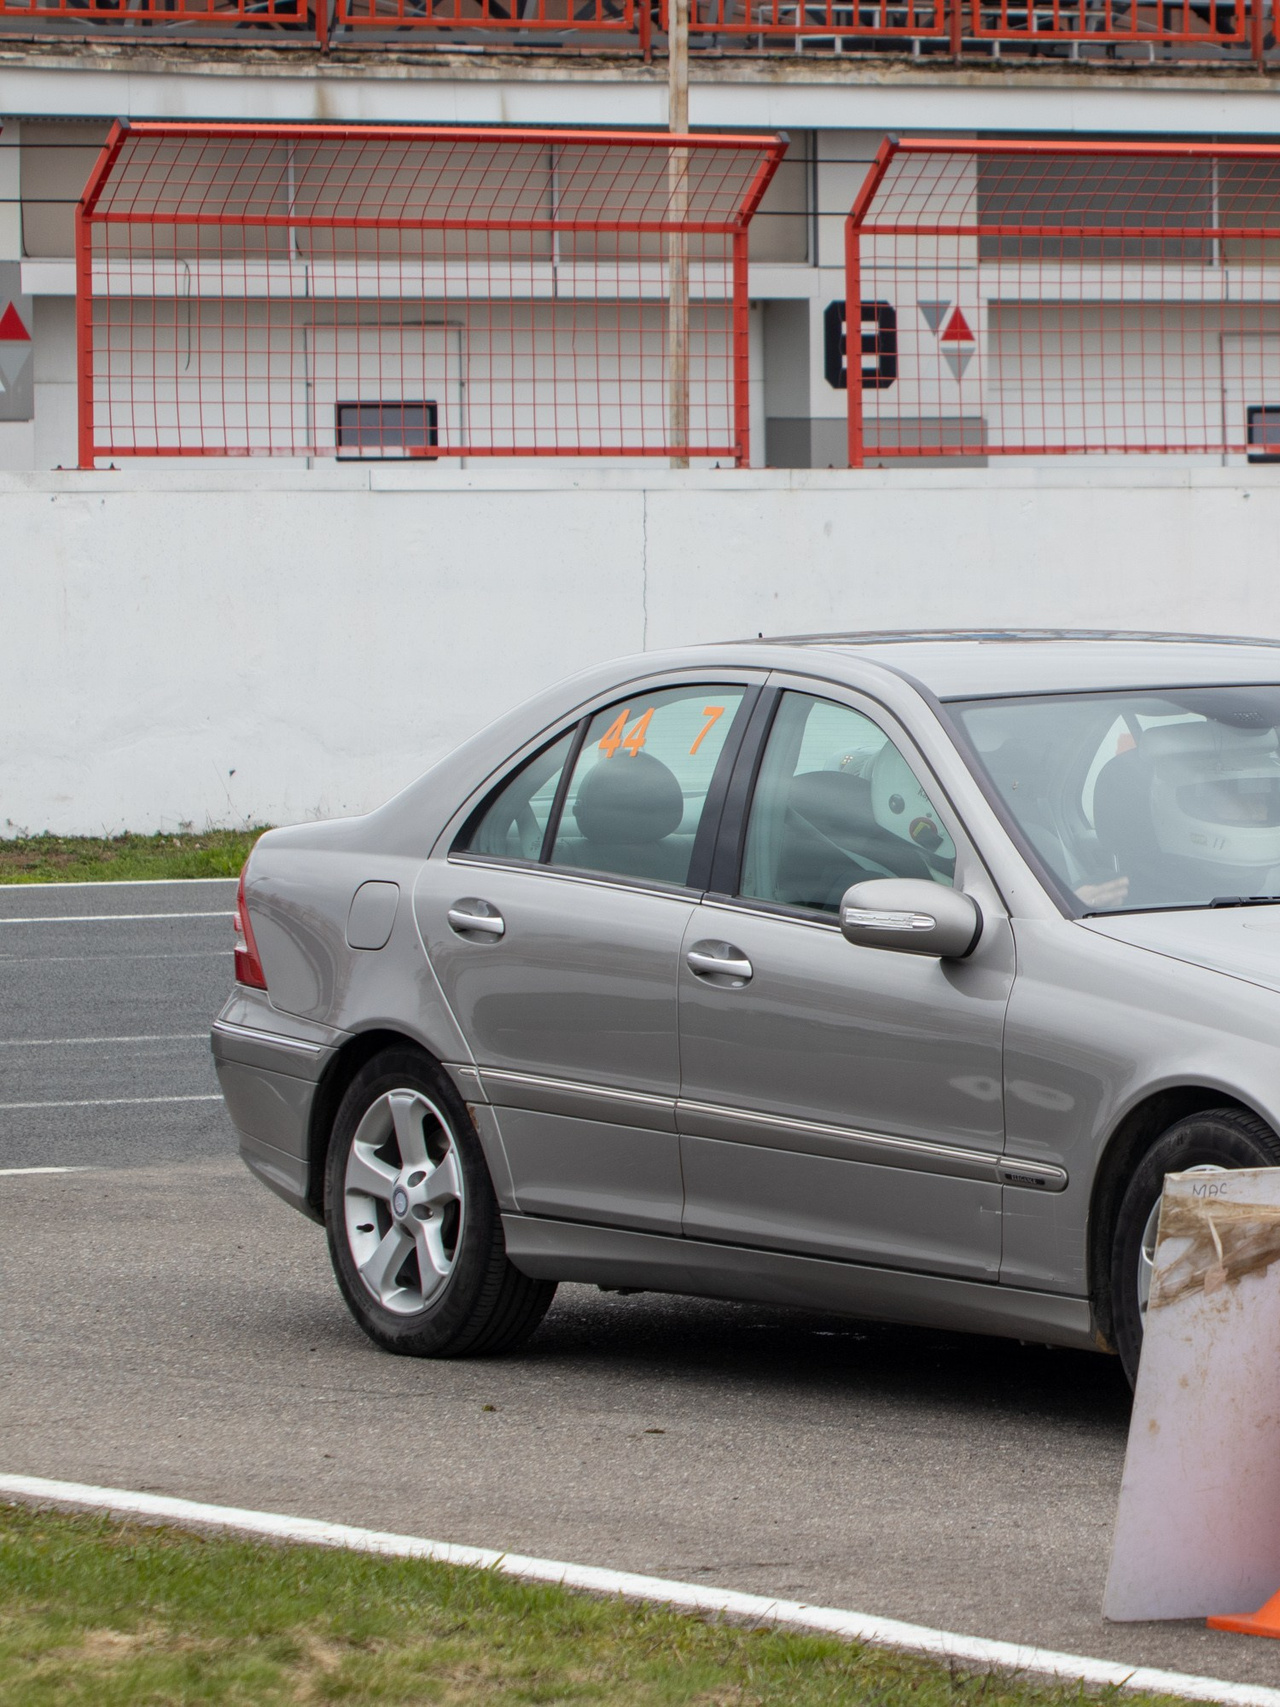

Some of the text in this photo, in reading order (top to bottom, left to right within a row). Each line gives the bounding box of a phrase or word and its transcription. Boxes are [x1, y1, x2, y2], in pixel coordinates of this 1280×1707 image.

[824, 300, 897, 389] 8
[598, 706, 725, 759] 44 7
